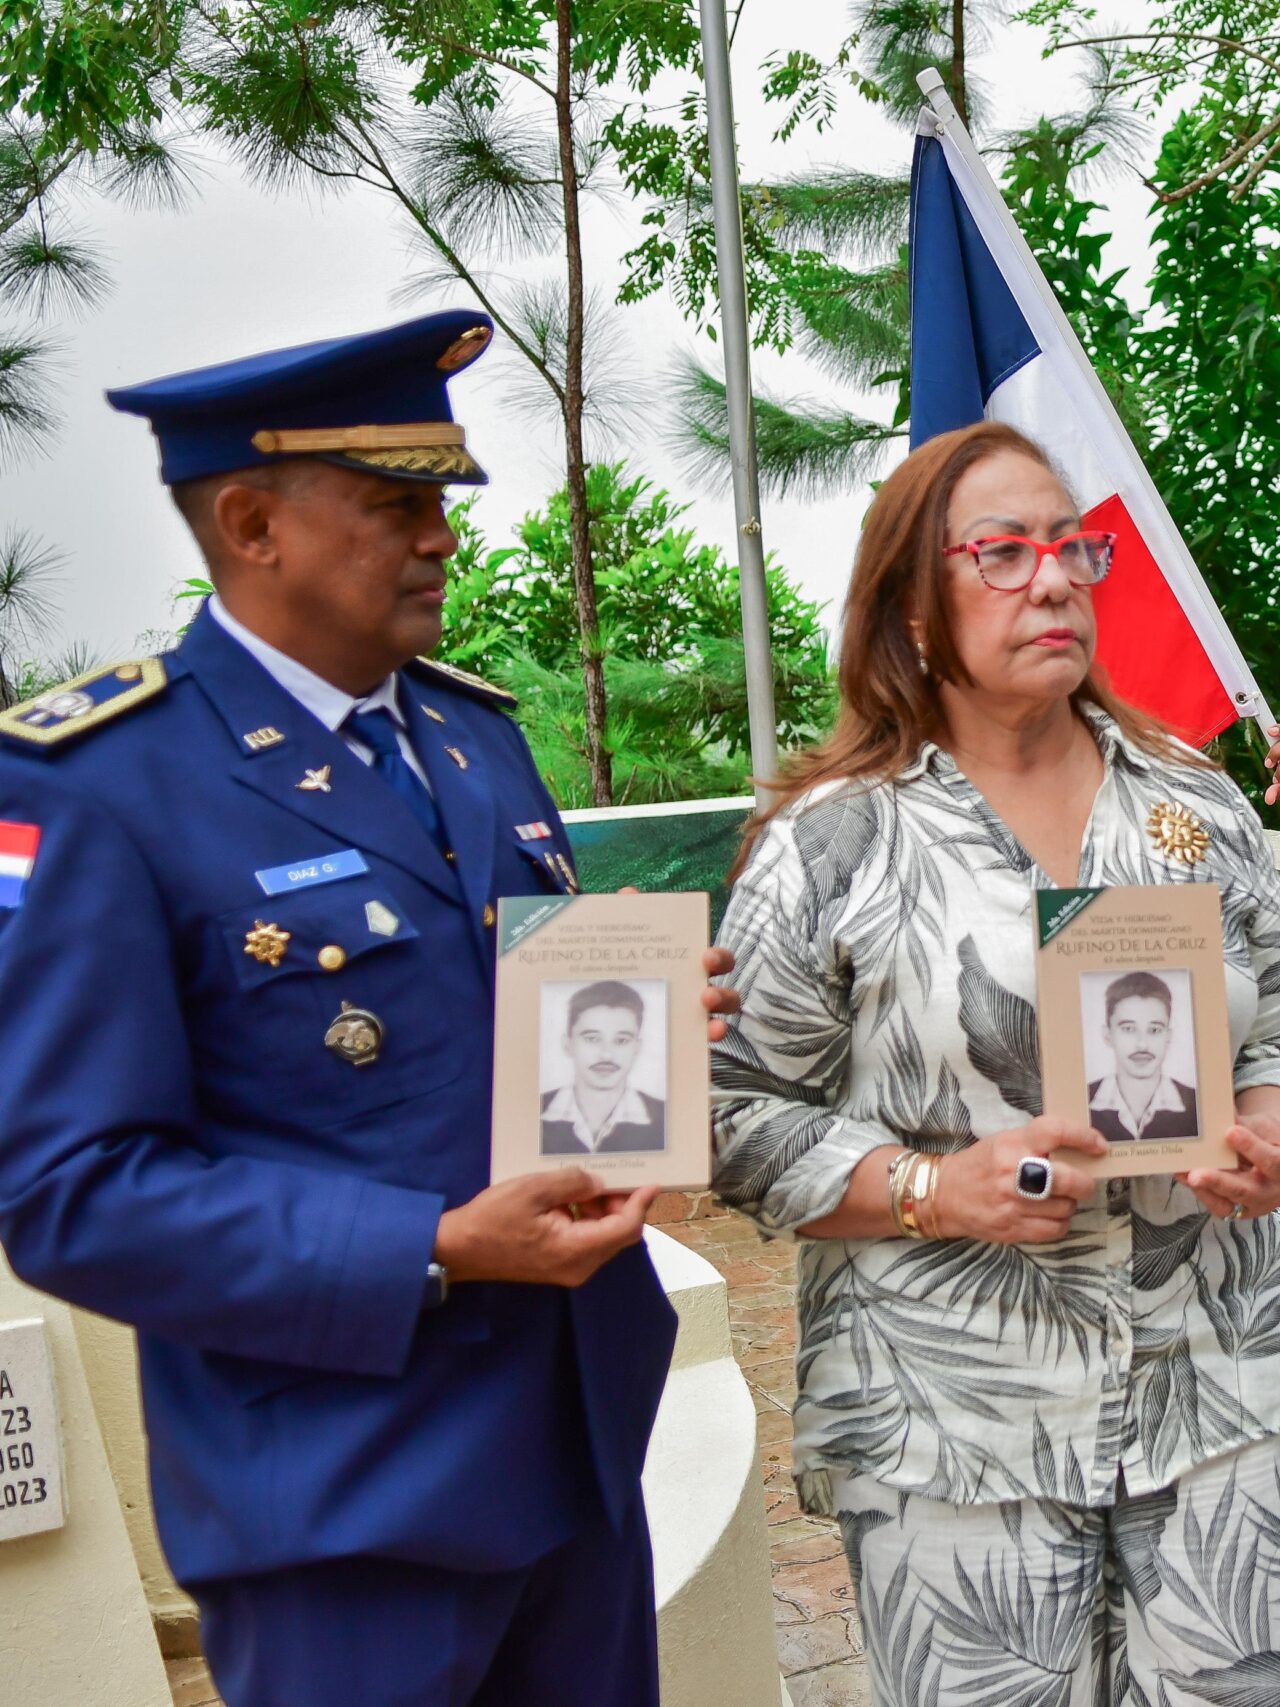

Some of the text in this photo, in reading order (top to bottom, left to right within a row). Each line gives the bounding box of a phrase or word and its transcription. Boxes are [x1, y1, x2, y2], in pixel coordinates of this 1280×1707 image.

[1089, 915, 1114, 923] VIDA
[1128, 925, 1192, 935] DOMINICANO
[1056, 941, 1116, 955] RUFINO
[1165, 936, 1208, 950] CRUZ
[518, 949, 584, 964] RUFINO
[641, 946, 689, 960] CRUZ
